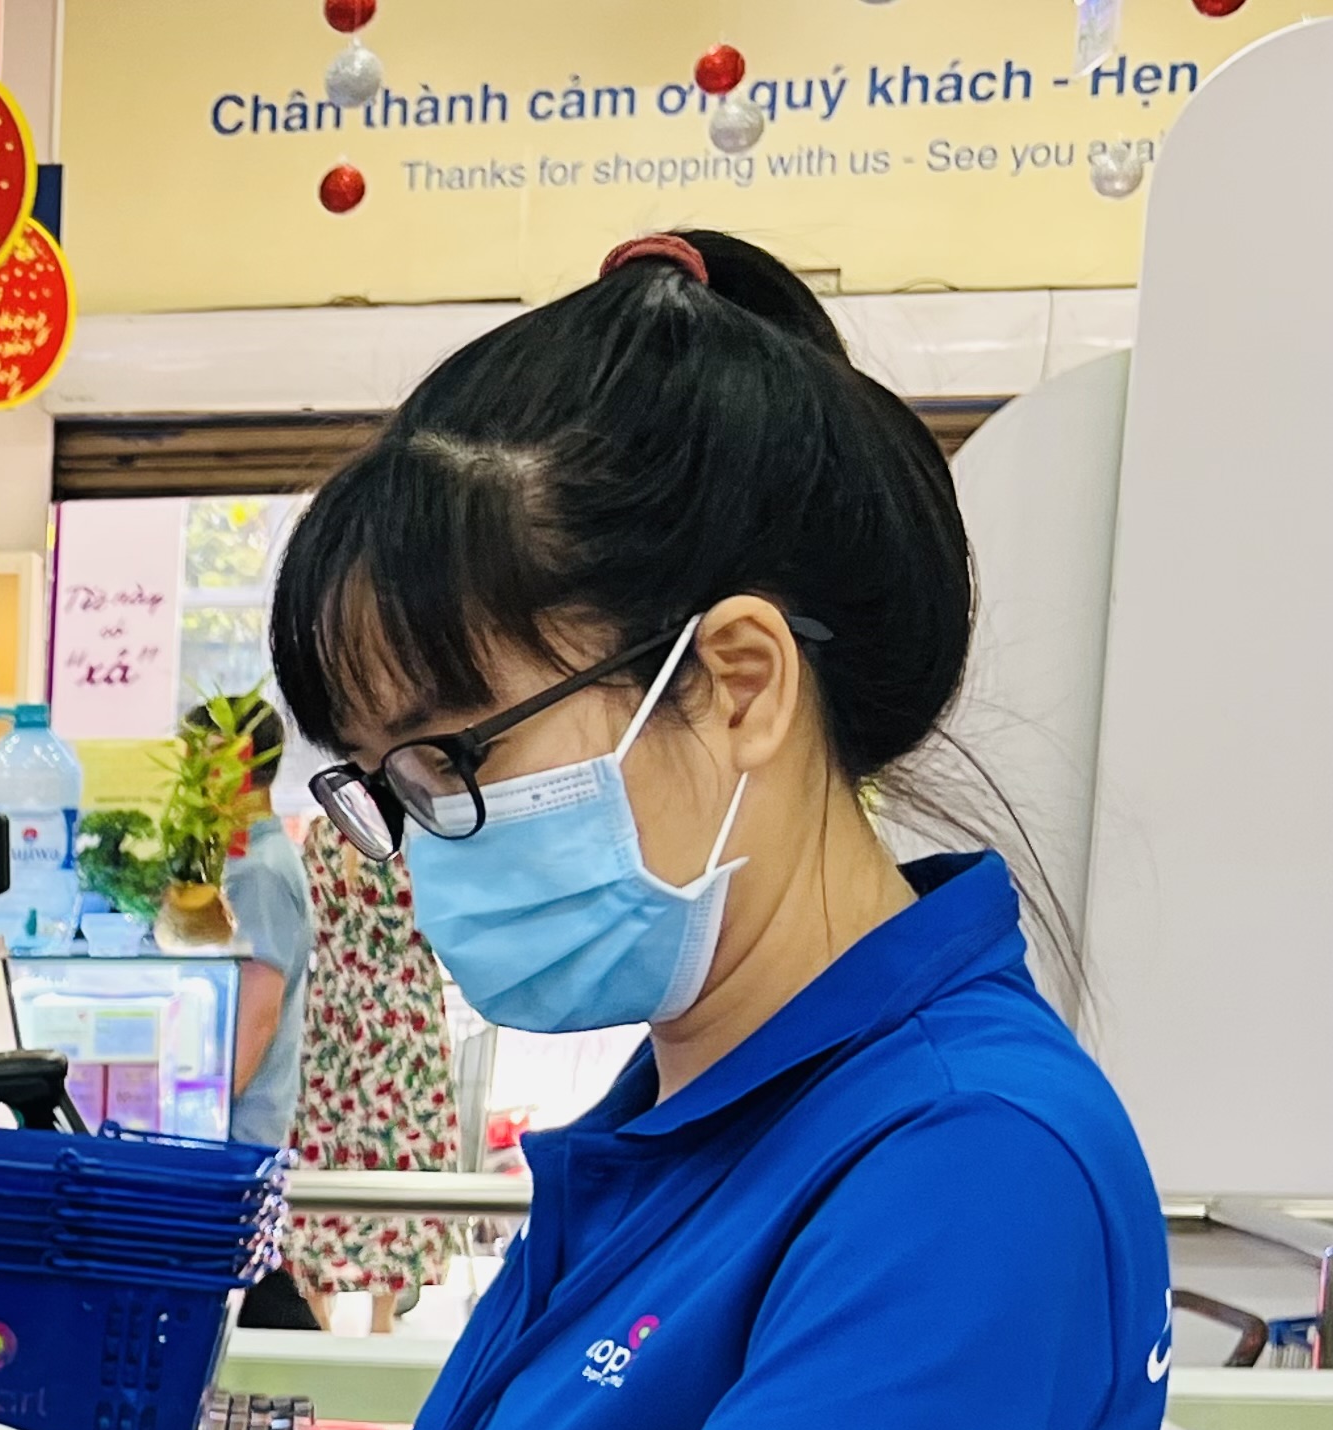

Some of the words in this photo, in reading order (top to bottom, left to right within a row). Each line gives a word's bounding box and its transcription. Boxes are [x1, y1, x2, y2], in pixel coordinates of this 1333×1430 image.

[211, 88, 342, 136] Chân
[364, 82, 508, 128] thành
[528, 73, 637, 121] cảm
[749, 64, 848, 122] quý
[867, 58, 1033, 107] khách
[1090, 54, 1198, 109] Hẹn
[402, 156, 527, 192] Thanks
[539, 154, 583, 187] for
[592, 147, 755, 189] shopping
[767, 144, 837, 178] with
[848, 147, 891, 175] us
[925, 137, 999, 173] See
[1010, 141, 1075, 177] you
